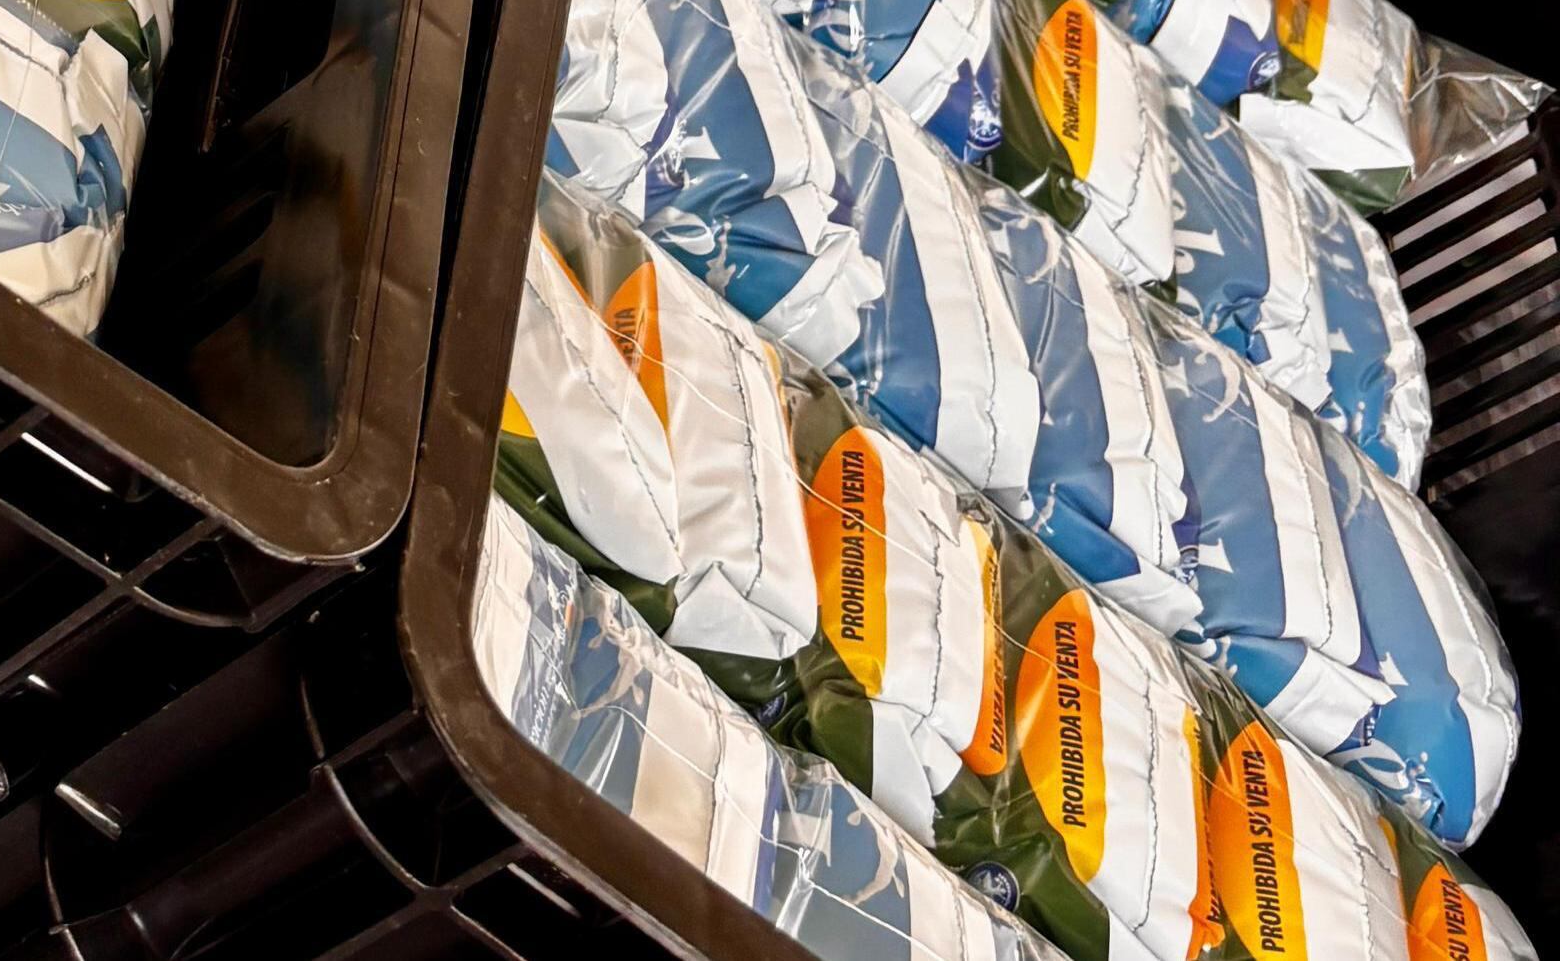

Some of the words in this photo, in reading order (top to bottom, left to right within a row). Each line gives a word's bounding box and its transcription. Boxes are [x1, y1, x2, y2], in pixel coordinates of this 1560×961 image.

[842, 450, 865, 506] VENTA
[842, 507, 865, 531] SU
[841, 532, 865, 641] PROHIBIDA
[1054, 620, 1080, 682] VENTA
[1058, 683, 1082, 712] SU
[1062, 713, 1087, 829] PROHIBIDA
[1241, 749, 1271, 812] VENTA
[1248, 812, 1273, 839] SU
[1251, 842, 1285, 953] PROHIBIDA
[1441, 879, 1467, 935] VENTA
